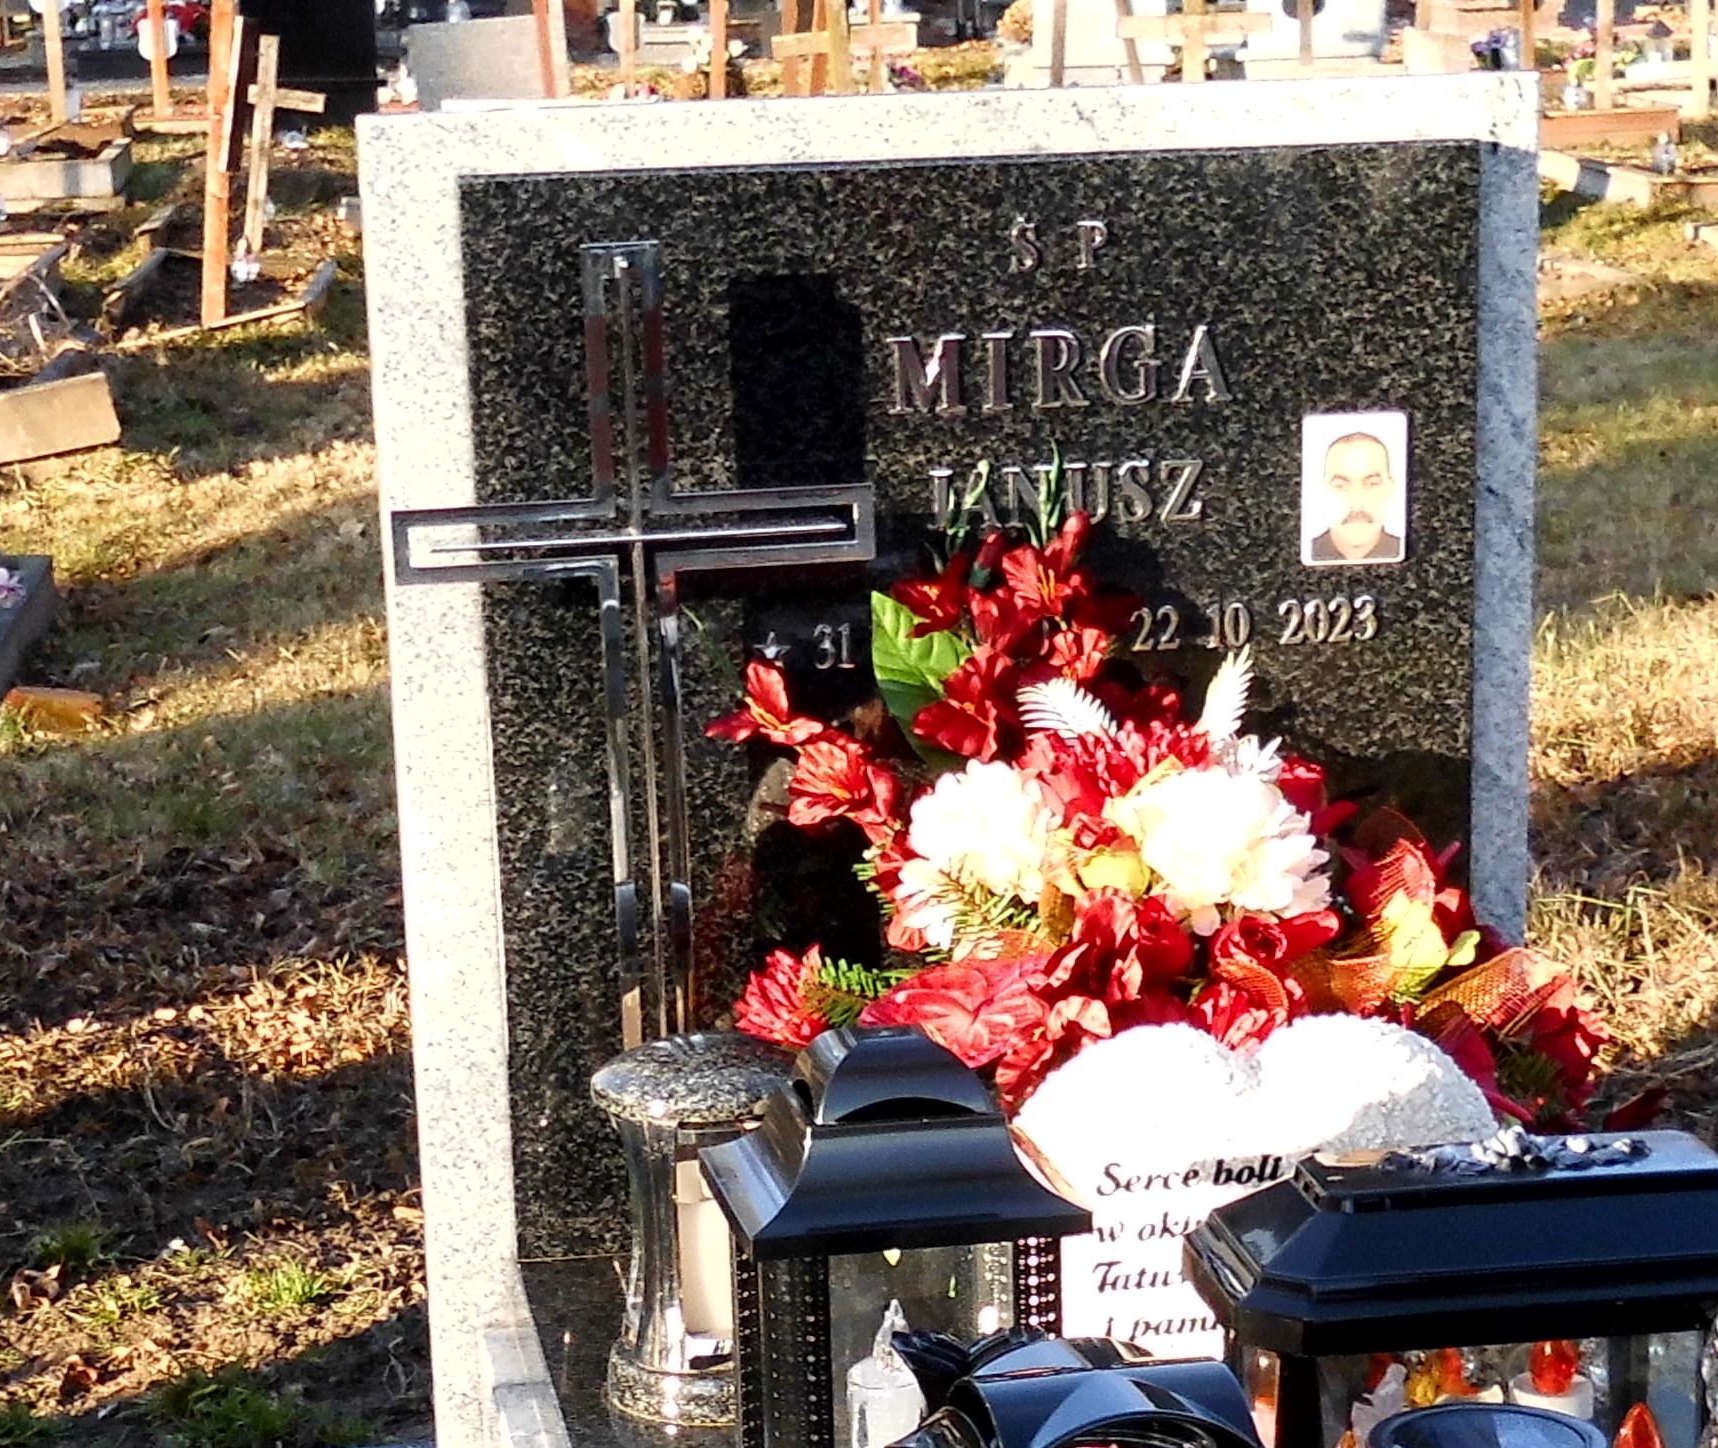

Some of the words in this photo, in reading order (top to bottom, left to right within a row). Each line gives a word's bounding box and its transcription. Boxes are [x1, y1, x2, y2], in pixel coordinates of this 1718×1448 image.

[1076, 220, 1109, 268] P
[885, 324, 1233, 415] MIRGA
[813, 622, 856, 669] 31
[1130, 605, 1181, 652] 22
[1206, 602, 1251, 648] 10
[1279, 595, 1379, 645] 2023
[1096, 1162, 1200, 1197] Serce
[1092, 1260, 1188, 1294] Tatu
